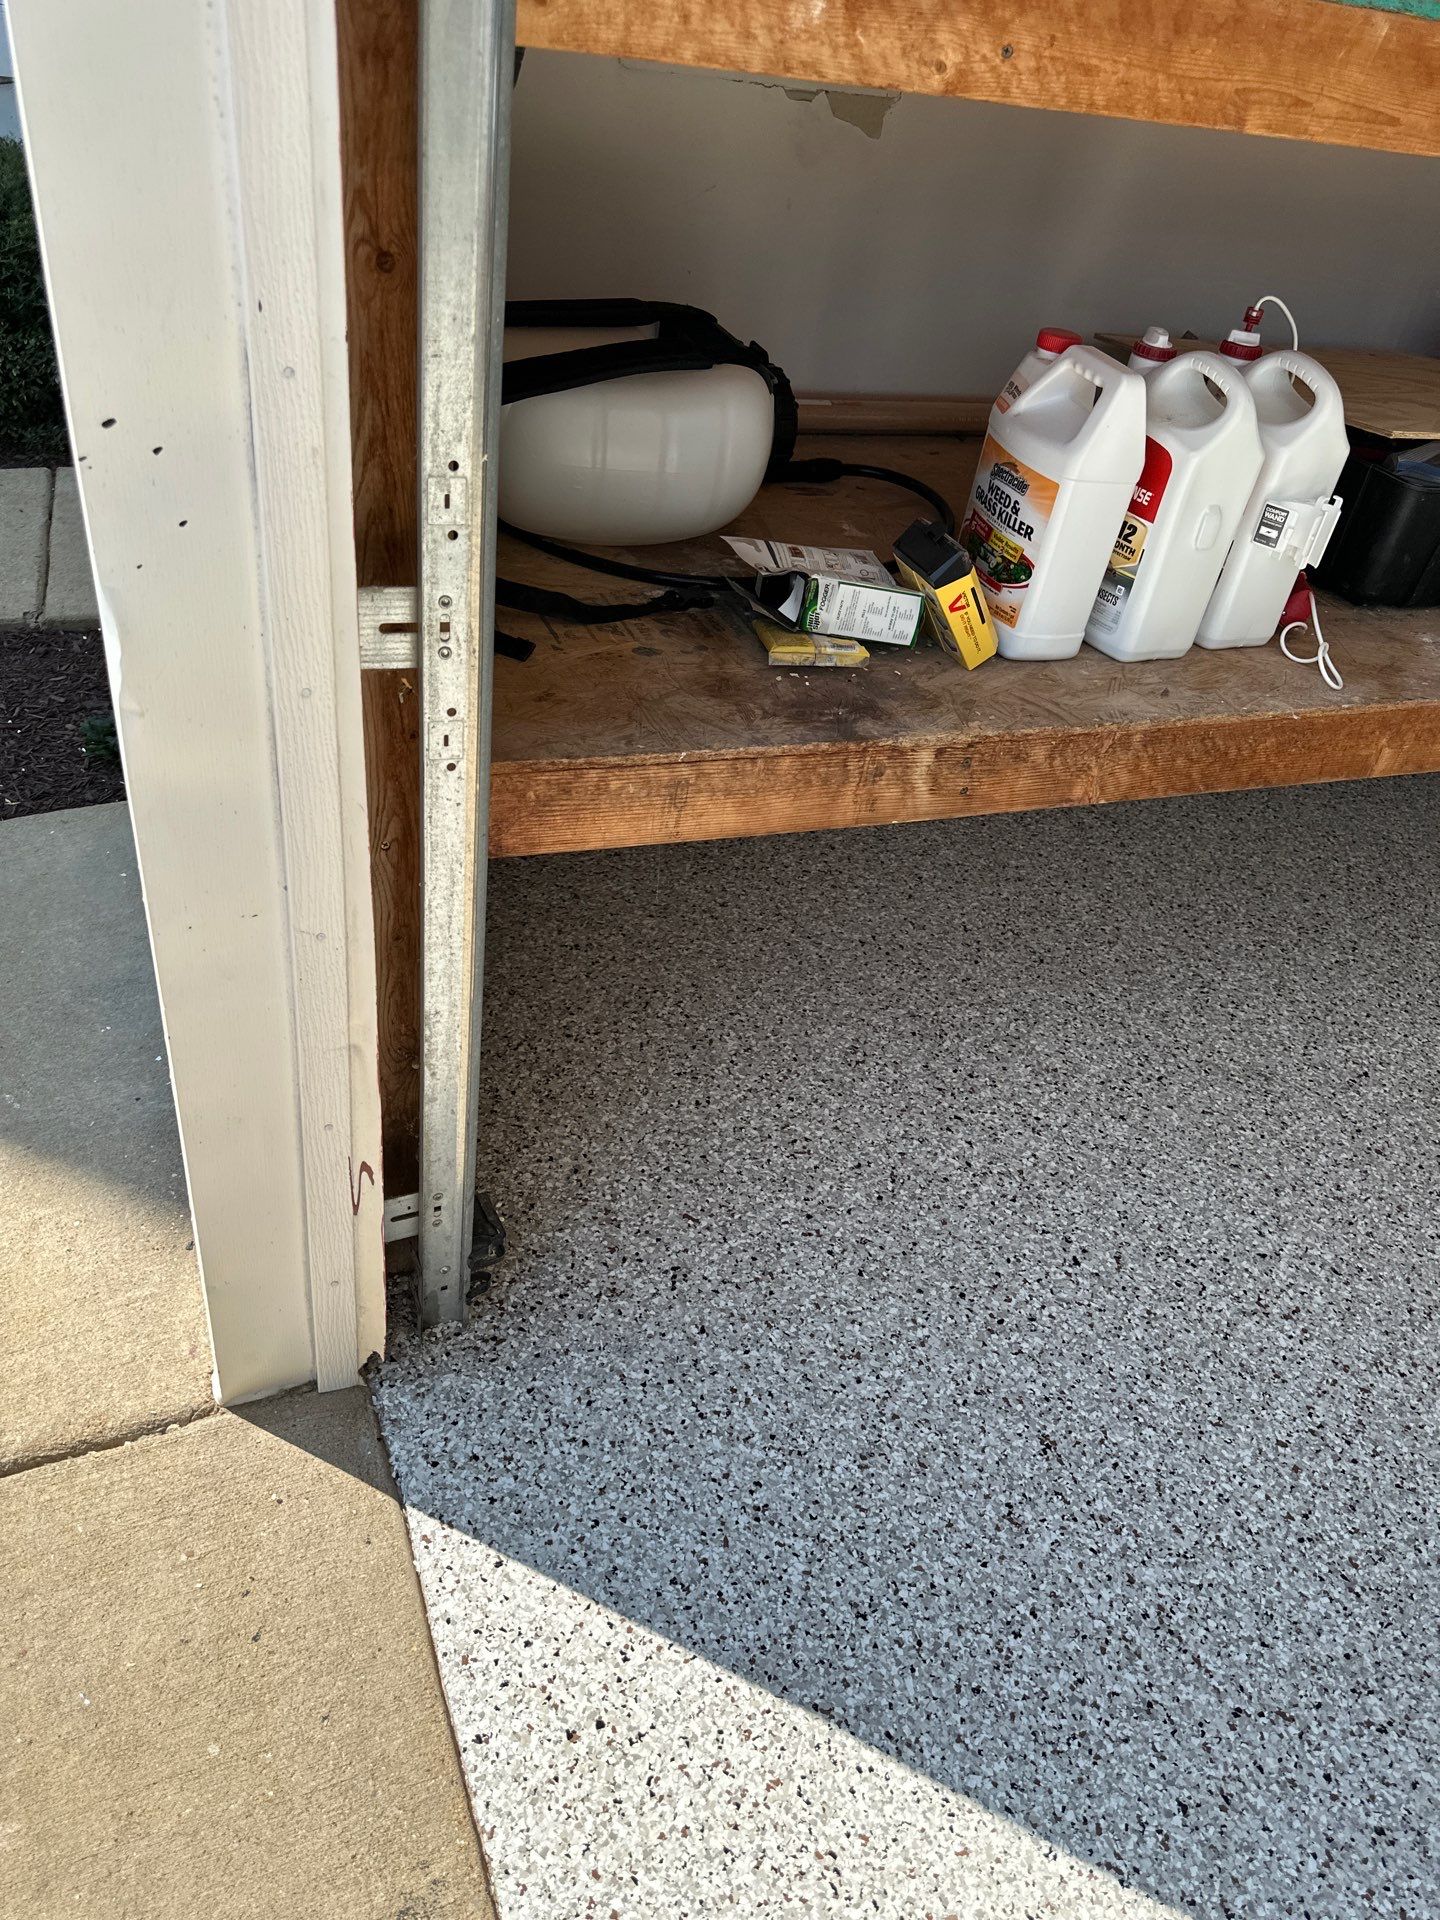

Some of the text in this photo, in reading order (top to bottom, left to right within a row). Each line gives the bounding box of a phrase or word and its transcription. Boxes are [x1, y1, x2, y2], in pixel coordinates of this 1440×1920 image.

[990, 463, 1029, 494] Spectracide
[988, 480, 1021, 517] WEED &
[1132, 486, 1152, 506] NSE
[975, 485, 998, 516] GRASS
[997, 506, 1034, 542] KILLER
[1264, 511, 1285, 523] WAND
[1117, 520, 1138, 544] 12
[1114, 540, 1137, 557] ONTH
[1098, 588, 1119, 607] NSECTS
